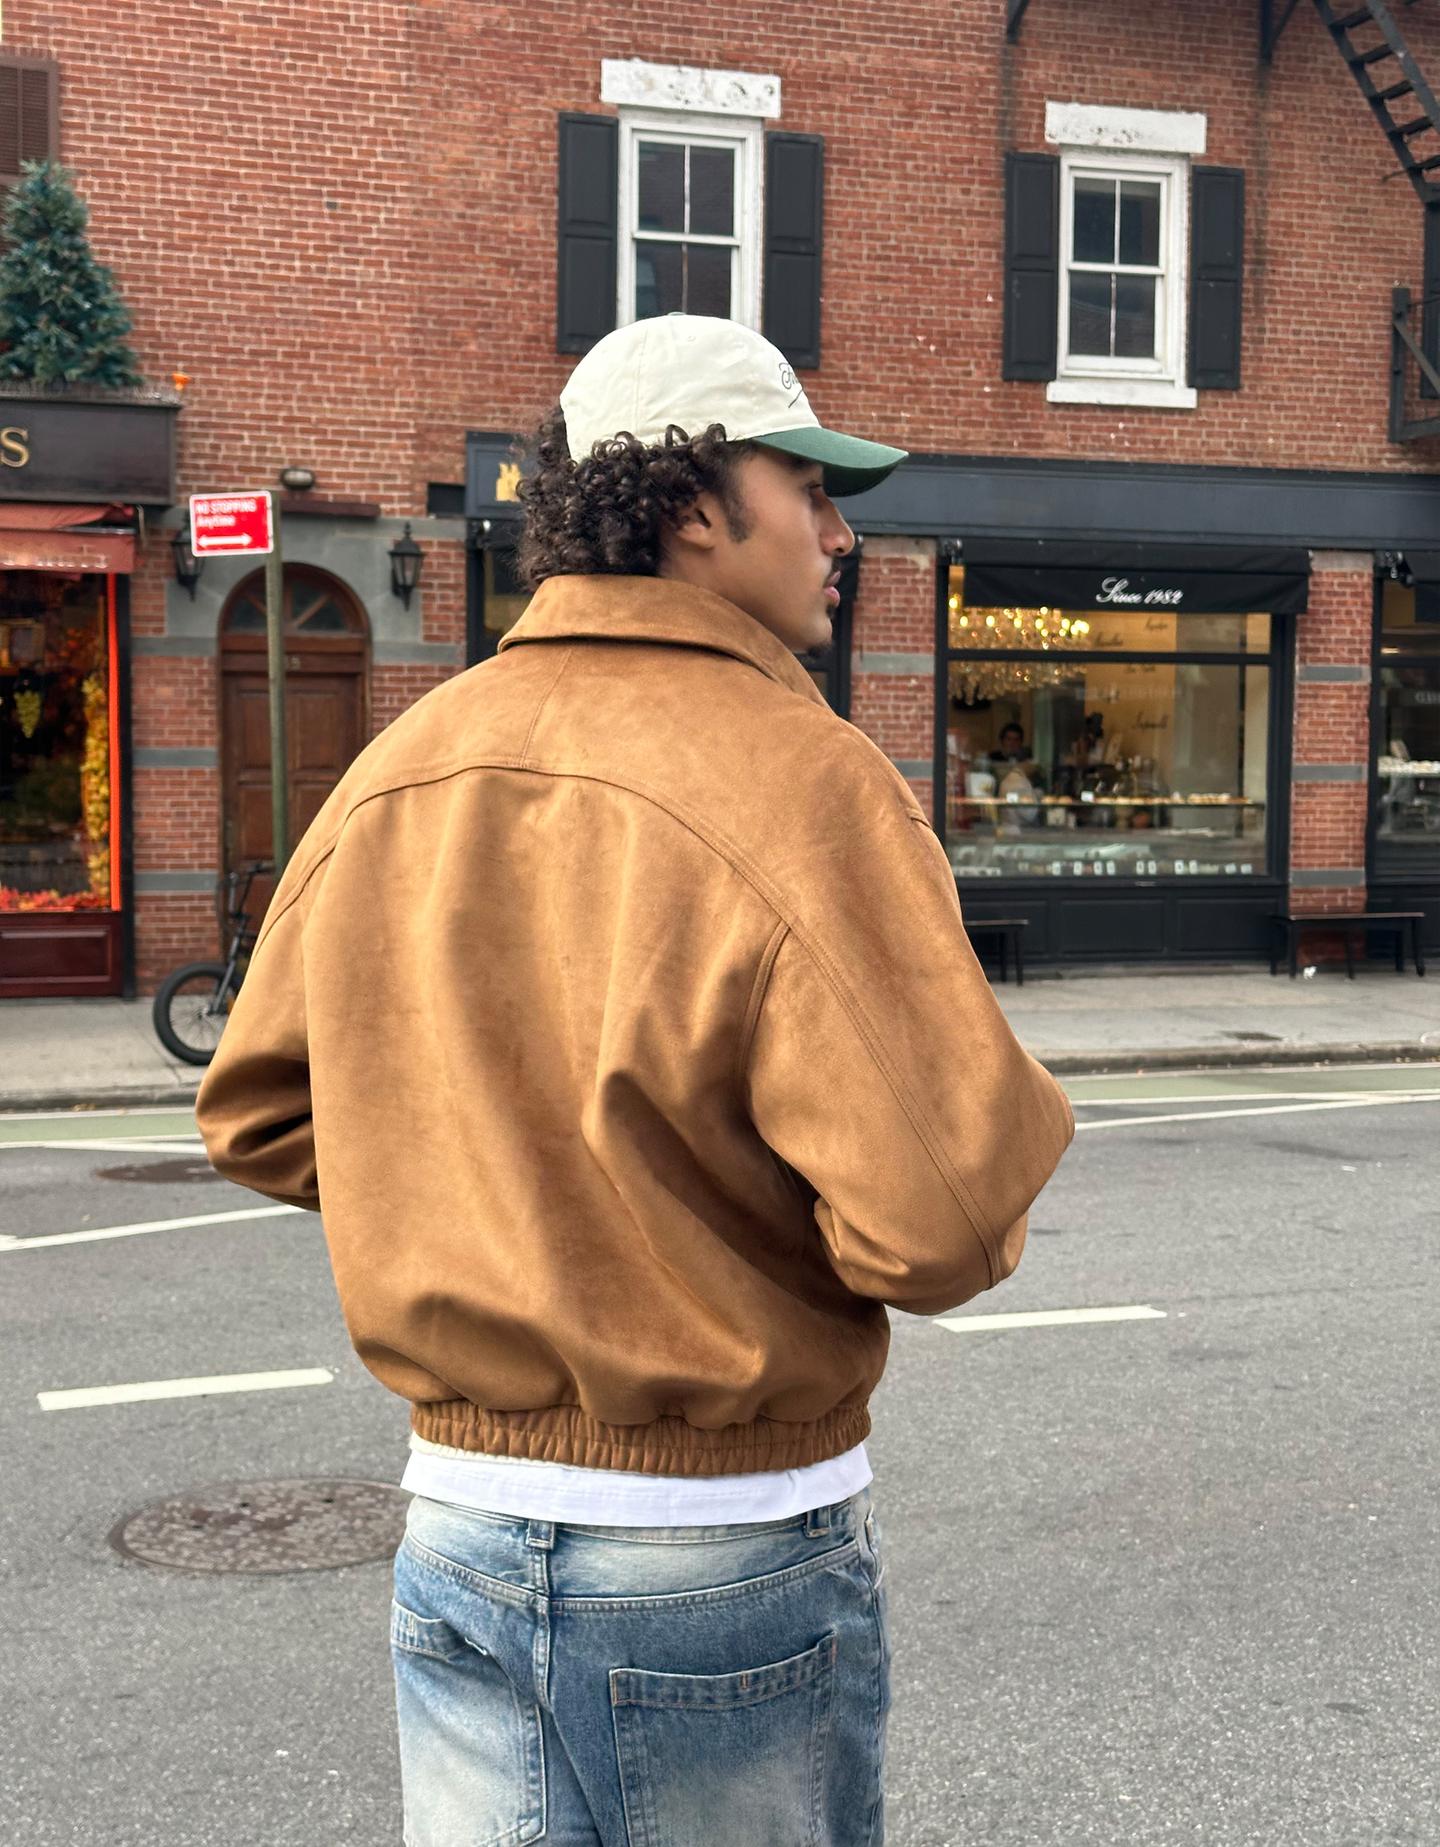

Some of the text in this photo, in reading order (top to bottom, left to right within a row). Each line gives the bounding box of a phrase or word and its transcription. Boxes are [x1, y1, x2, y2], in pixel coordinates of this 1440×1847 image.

[196, 499, 257, 515] NO STOPPING
[1095, 576, 1142, 604] Since
